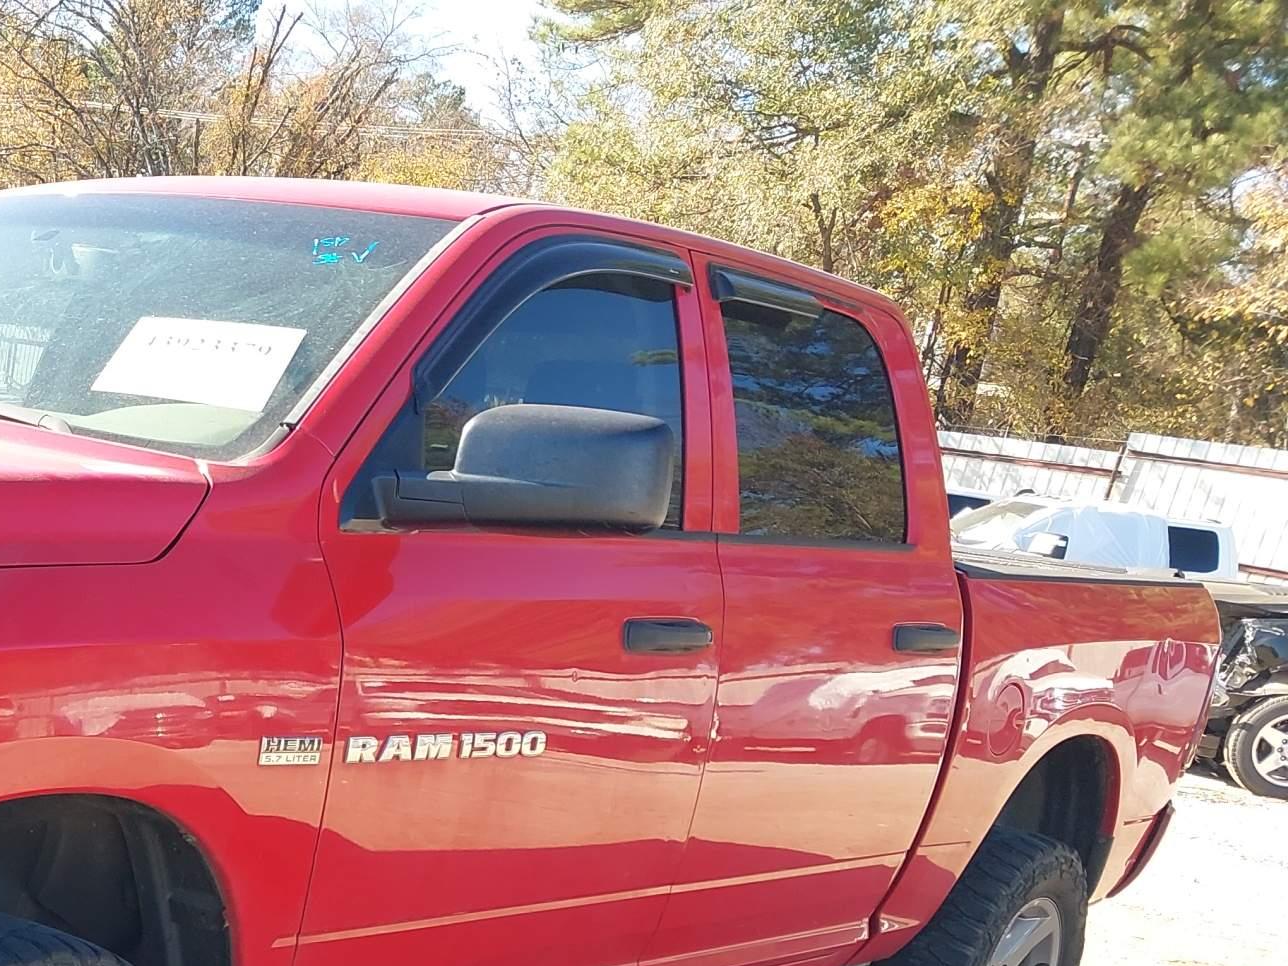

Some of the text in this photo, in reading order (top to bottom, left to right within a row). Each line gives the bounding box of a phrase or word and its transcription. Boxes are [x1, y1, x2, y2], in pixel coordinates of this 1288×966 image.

[262, 737, 323, 752] HEMI
[345, 730, 546, 764] RAM 1500
[264, 754, 317, 763] 5.7 LITER
